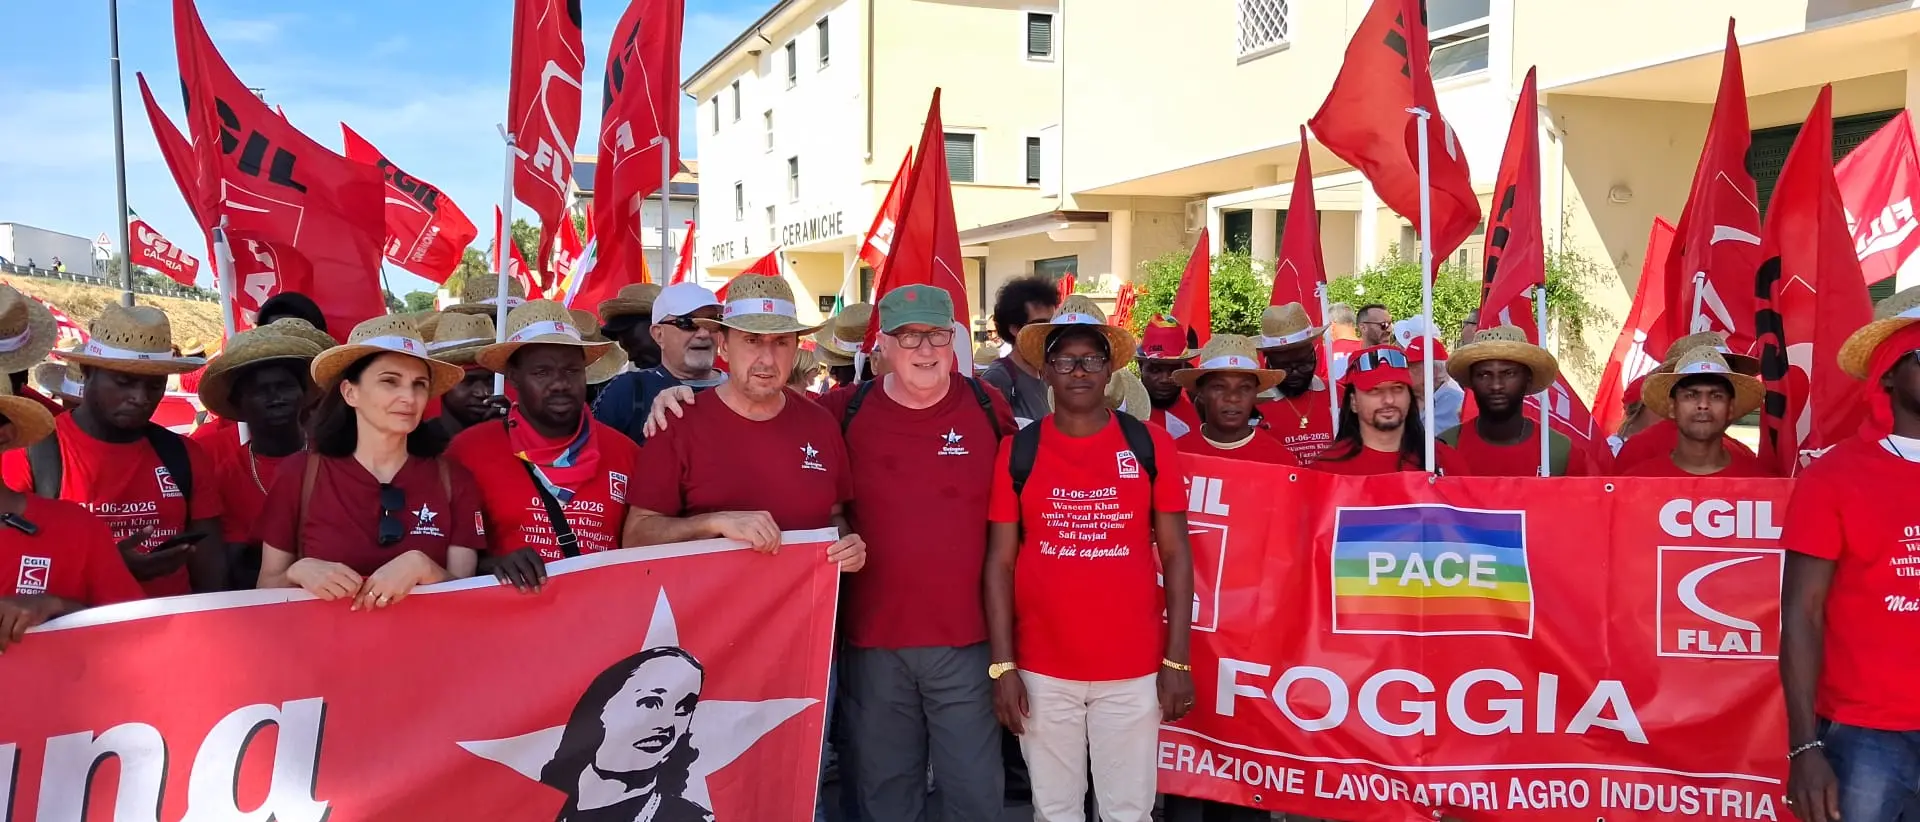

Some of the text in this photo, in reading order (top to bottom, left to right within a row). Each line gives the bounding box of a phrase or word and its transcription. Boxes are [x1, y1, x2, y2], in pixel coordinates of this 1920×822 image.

[213, 96, 307, 194] GIL
[712, 241, 734, 262] PORTE
[782, 211, 843, 246] CERAMICHE
[1284, 433, 1329, 443] 01-06-2026
[611, 472, 627, 482] CGIL
[1052, 486, 1117, 499] 01-06-2026
[1052, 501, 1120, 511] Waseem Khan
[131, 516, 161, 527] Khan
[579, 516, 603, 528] Khan
[1041, 511, 1064, 520] Amin
[1093, 511, 1134, 522] Khogjani
[1658, 498, 1784, 540] CGIL
[520, 523, 546, 534] Amin
[1046, 520, 1070, 528] Ullah
[524, 534, 553, 546] Ullah
[1058, 530, 1077, 540] Safi
[539, 548, 561, 559] Safi
[1039, 540, 1130, 561] Mai più caporalato
[24, 557, 49, 567] CGIL
[1368, 551, 1498, 589] PACE
[23, 579, 42, 587] FLAI
[1885, 595, 1920, 612] Mai
[1677, 629, 1763, 653] FLAI
[1215, 656, 1650, 745] FOGGIA
[1314, 768, 1499, 811] LAVORATORI
[1507, 776, 1591, 811] AGRO
[1601, 776, 1780, 822] INDUSTRIA
